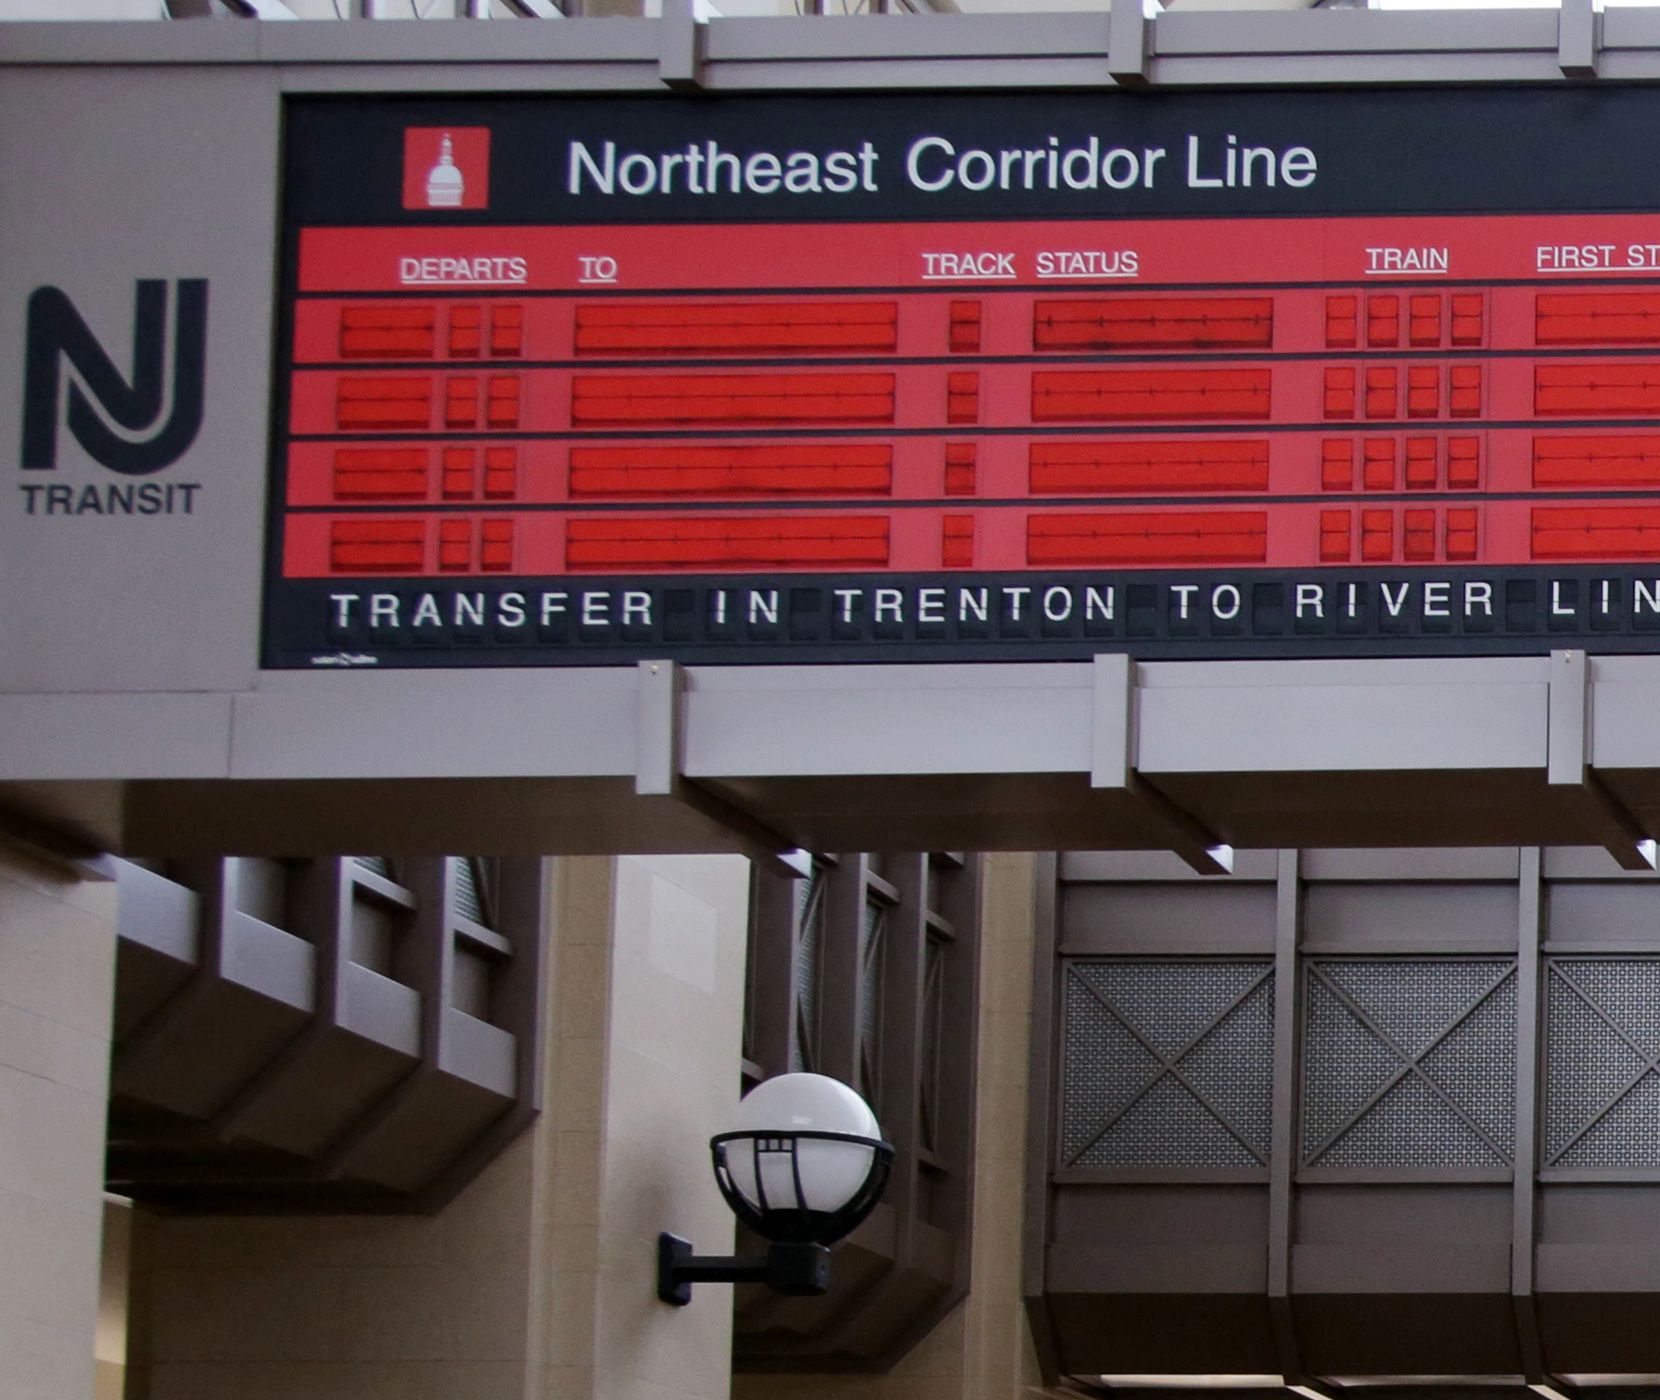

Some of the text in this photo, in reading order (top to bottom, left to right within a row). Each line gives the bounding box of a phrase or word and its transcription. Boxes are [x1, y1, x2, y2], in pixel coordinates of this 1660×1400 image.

[569, 133, 1318, 196] Northeast Corridor Line
[400, 256, 617, 281] DEPARTS TO
[922, 251, 1138, 276] TRACK STATUS
[1365, 248, 1448, 270] TRAIN
[1537, 245, 1616, 268] FIRST
[20, 278, 208, 476] NJ
[18, 482, 201, 516] TRANSIT
[331, 591, 652, 628] TRANSFER
[717, 590, 779, 624] IN
[834, 586, 1115, 623] TRENTON
[1170, 584, 1240, 619] TO
[1296, 582, 1494, 618] RIVER
